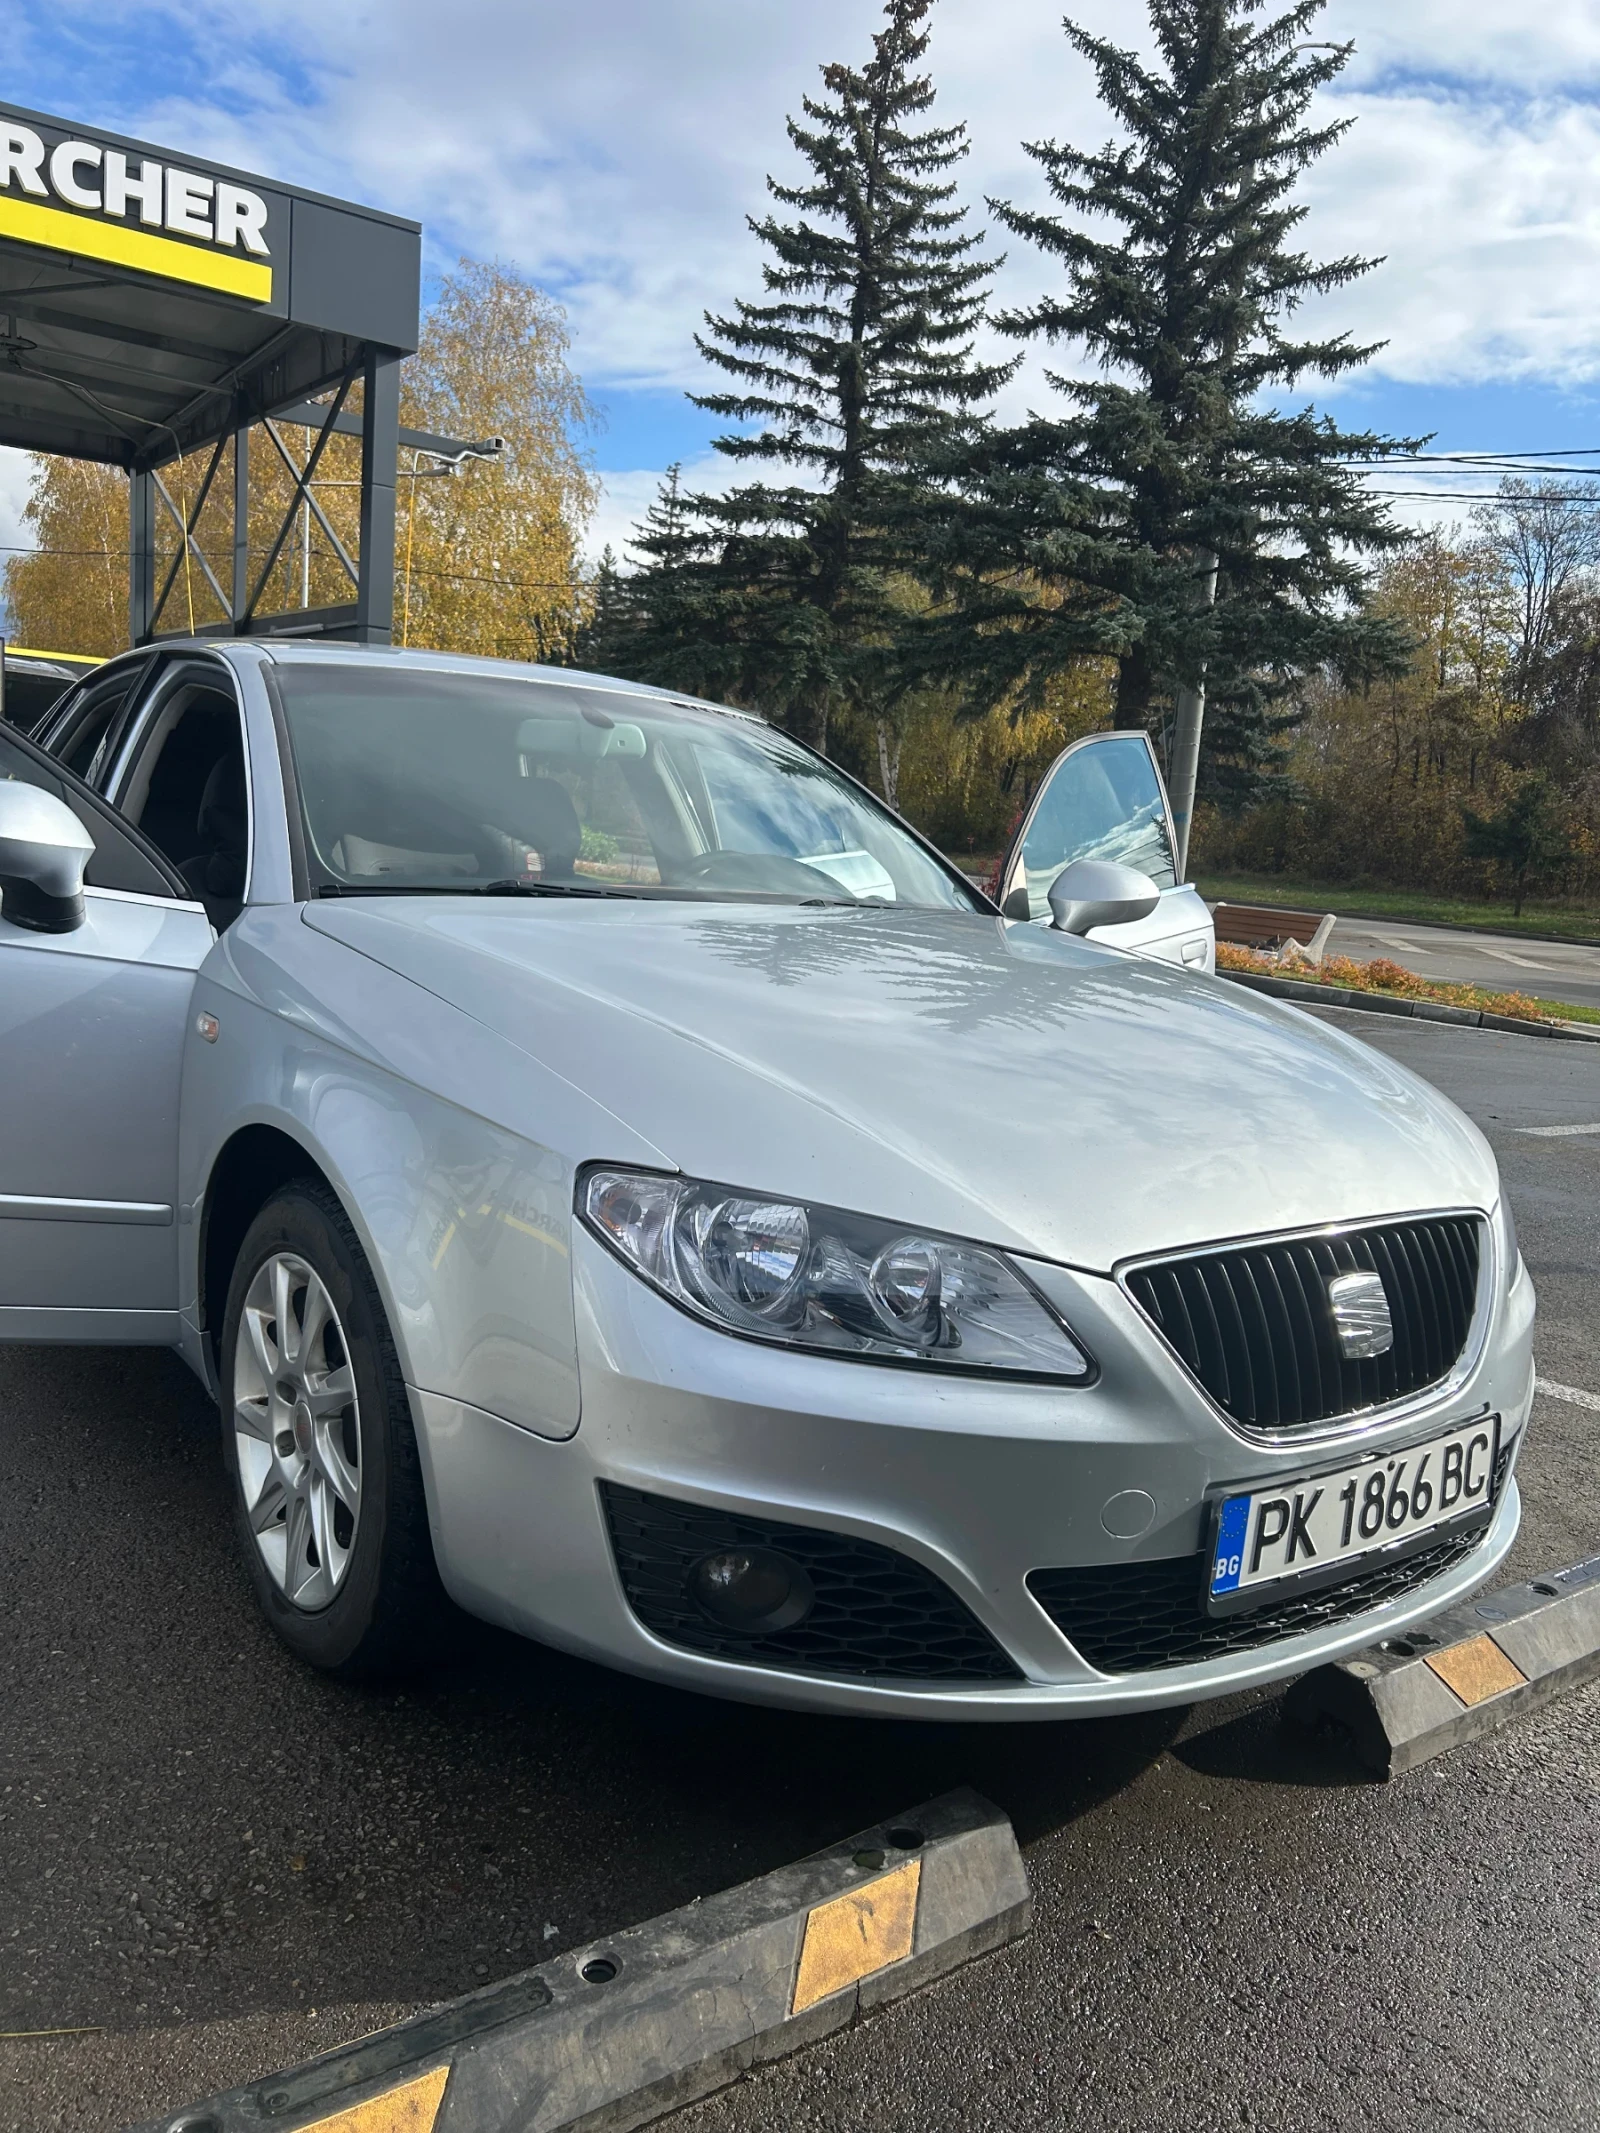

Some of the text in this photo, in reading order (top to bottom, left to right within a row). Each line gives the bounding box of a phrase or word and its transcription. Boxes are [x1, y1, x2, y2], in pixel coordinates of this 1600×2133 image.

[0, 120, 271, 257] RCHER
[1215, 1555, 1239, 1580] BG
[1248, 1431, 1489, 1574] PK 1866 BC
